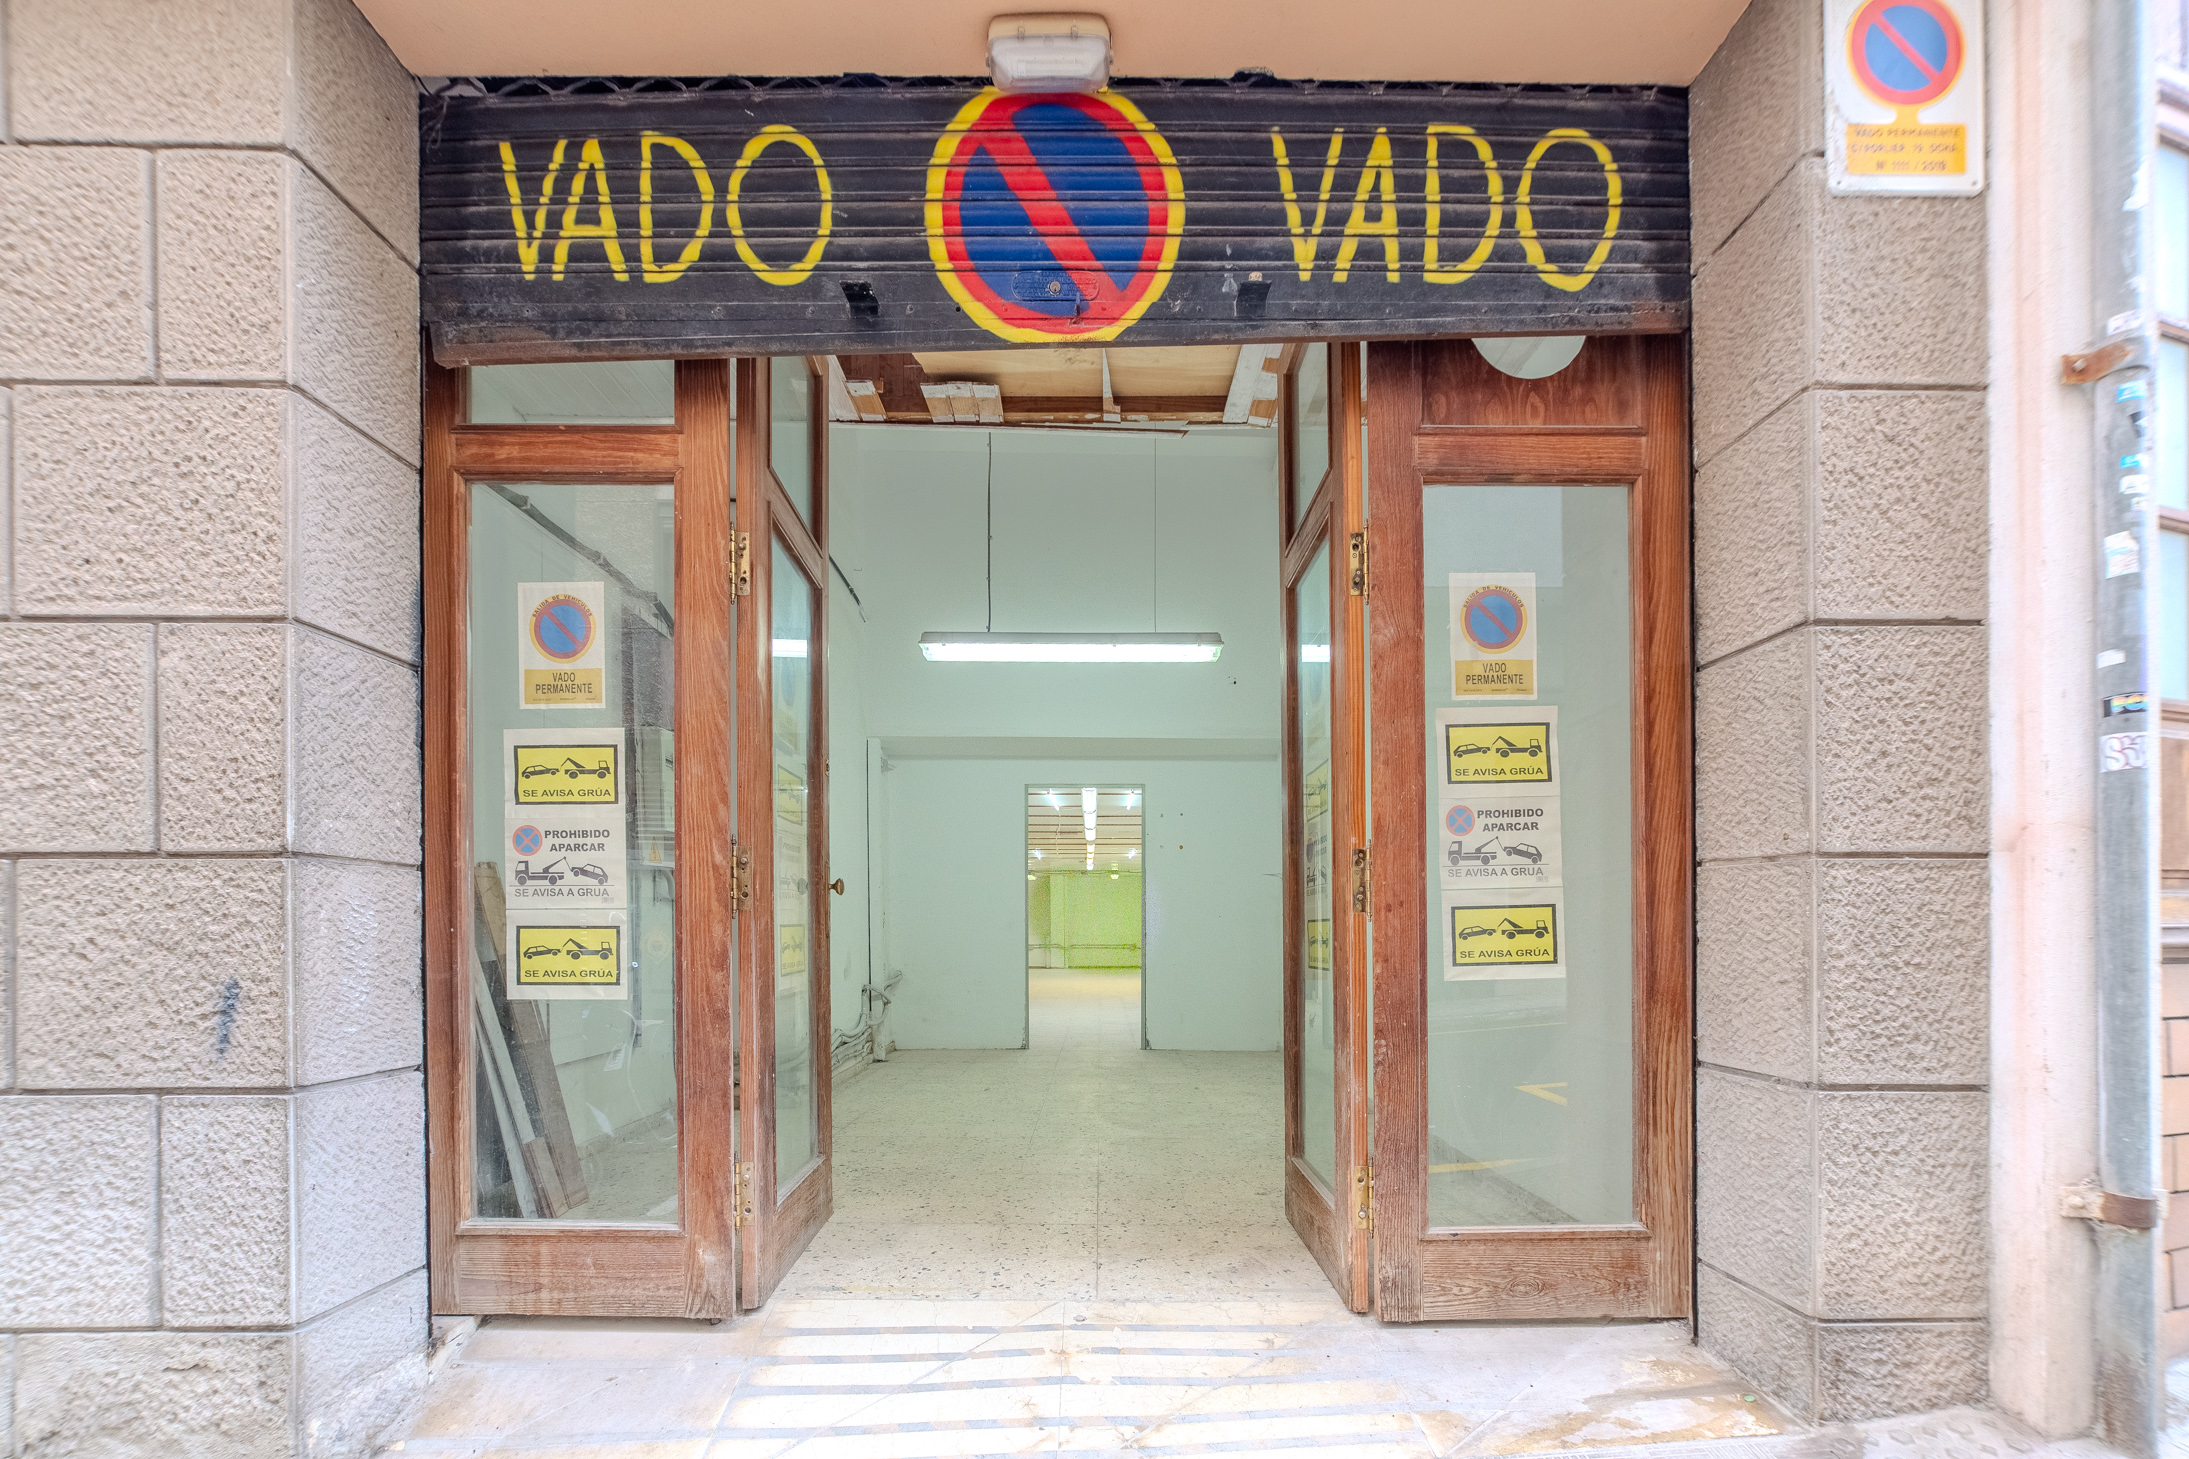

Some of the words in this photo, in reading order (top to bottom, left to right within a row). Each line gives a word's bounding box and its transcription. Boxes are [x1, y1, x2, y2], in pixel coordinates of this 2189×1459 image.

[500, 124, 832, 286] VADO
[1271, 122, 1622, 292] VADO
[1463, 590, 1480, 609] SALIDA
[1494, 585, 1524, 608] VEHICULOS
[532, 599, 550, 617] SALIDA
[564, 594, 593, 617] VEHICULOS
[1483, 662, 1507, 673] VADO
[552, 672, 576, 683] VADO
[1466, 674, 1524, 685] PERMANENTE
[536, 683, 593, 694] PERMANENTE
[1455, 768, 1470, 776] SE
[1472, 768, 1507, 776] AVISA
[1510, 765, 1543, 775] GRÚA
[523, 789, 538, 797] SE
[541, 789, 575, 797] AVISA
[577, 787, 611, 797] GRÚA
[1477, 808, 1544, 819] PROHIBIDO
[1482, 821, 1540, 832] APARCAR
[549, 843, 606, 852] APARCAR
[1447, 869, 1462, 878] SE
[1465, 868, 1498, 877] AVISA
[1500, 867, 1508, 877] A
[1511, 867, 1544, 877] GRUA
[514, 888, 529, 897] SE
[531, 888, 565, 897] AVISA
[567, 888, 575, 896] A
[577, 888, 610, 897] GRUA
[1460, 951, 1475, 959] SE
[1478, 949, 1513, 958] AVISA
[1516, 947, 1550, 956] GRÚA
[524, 970, 539, 978] SE
[579, 968, 613, 978] GRÚA
